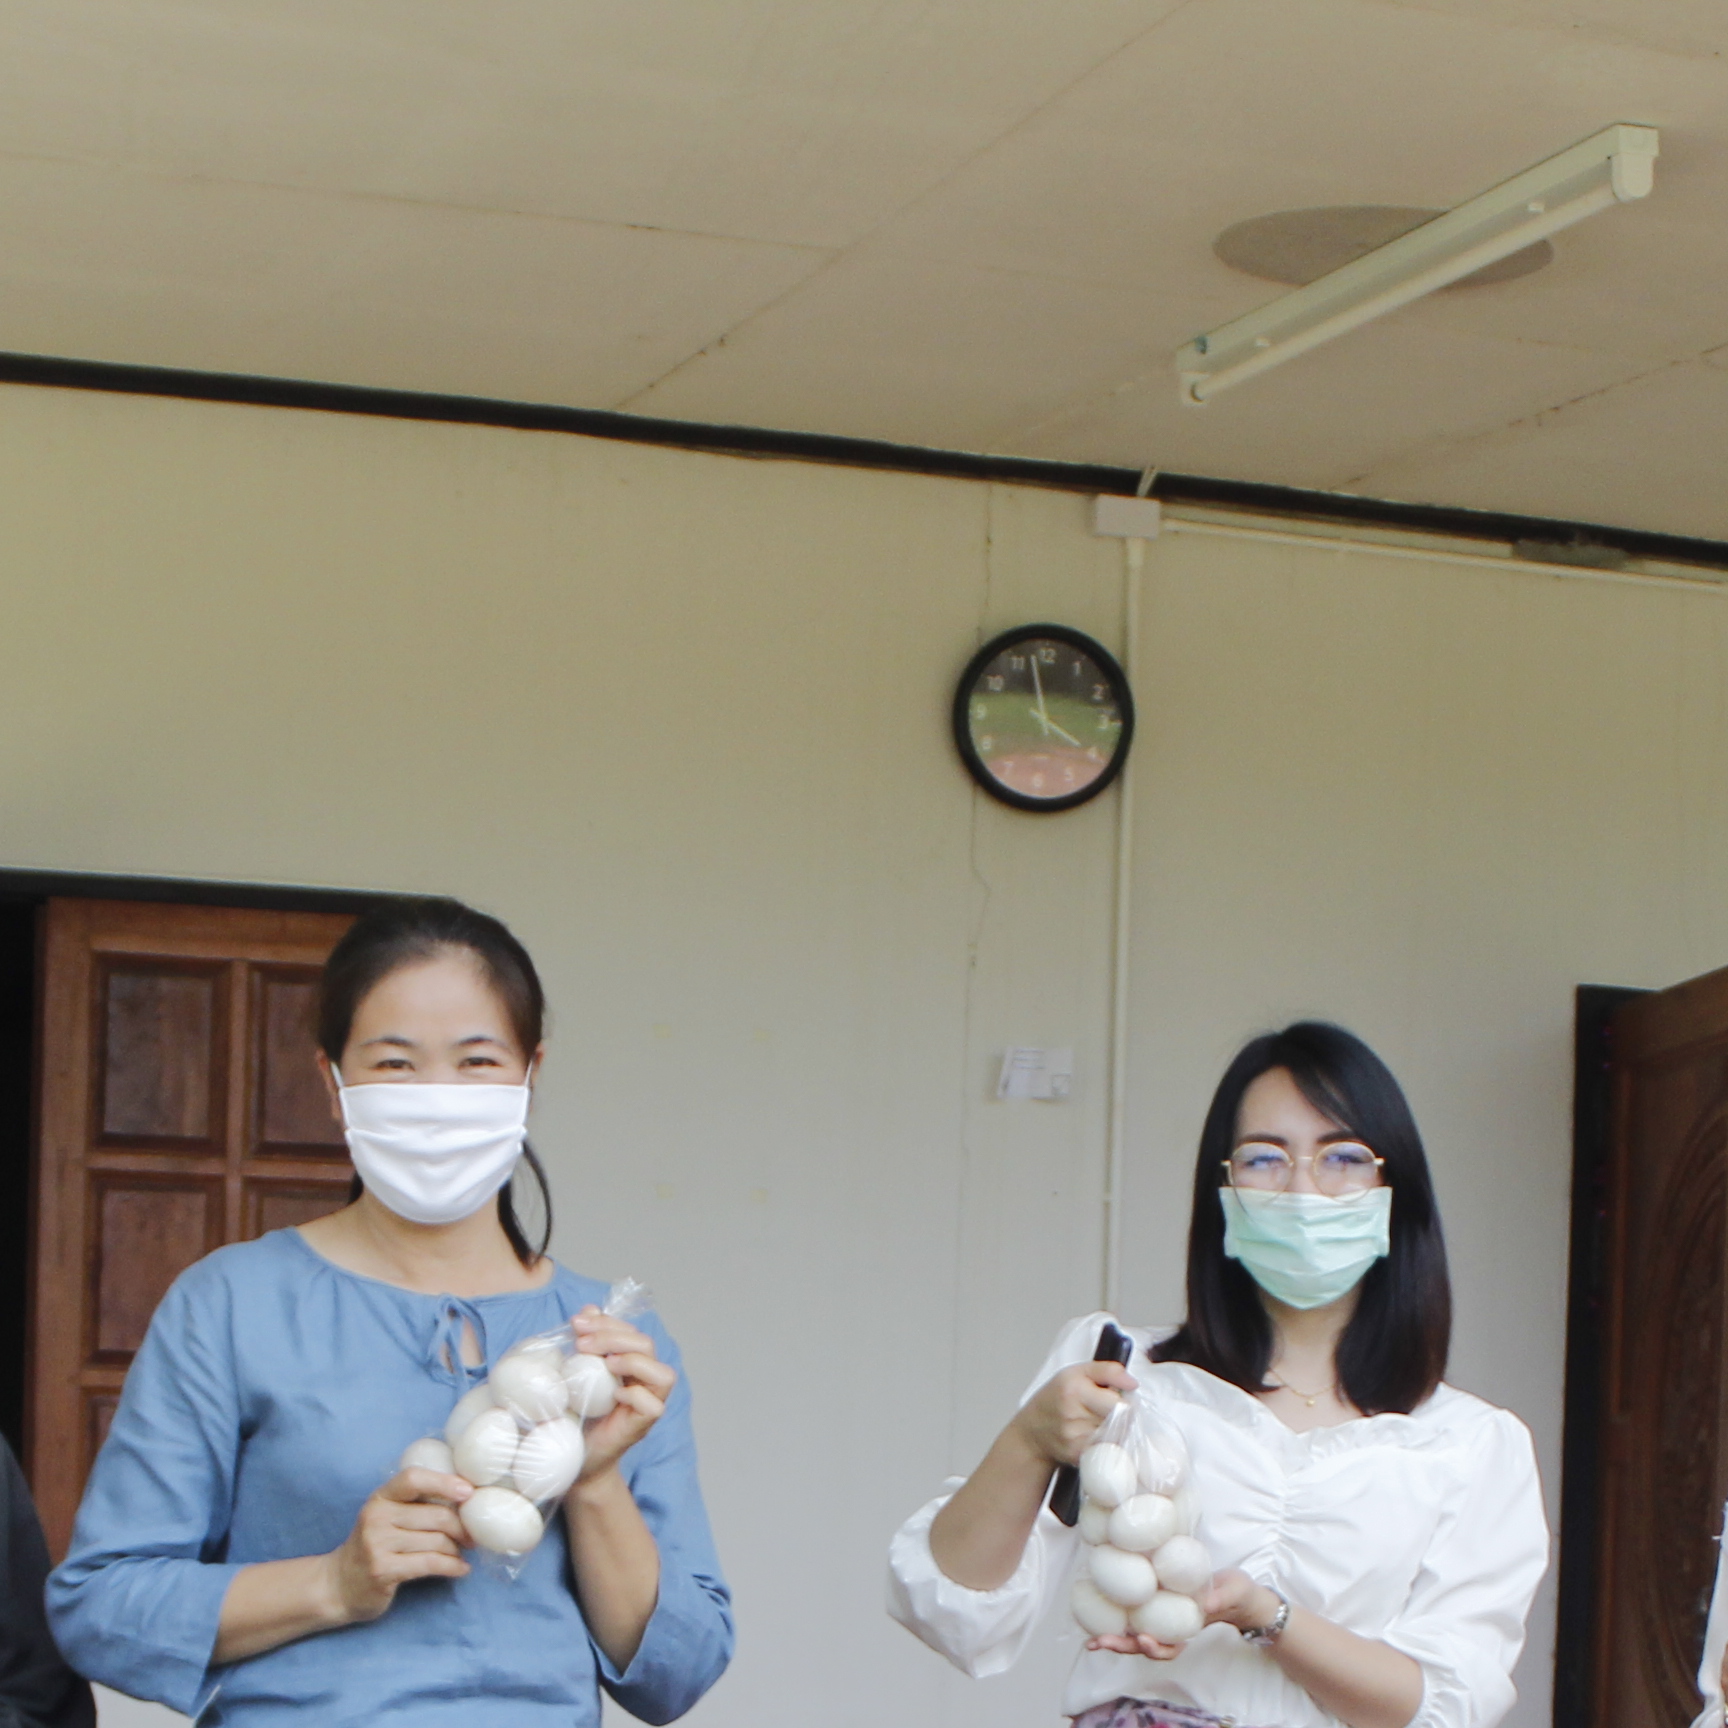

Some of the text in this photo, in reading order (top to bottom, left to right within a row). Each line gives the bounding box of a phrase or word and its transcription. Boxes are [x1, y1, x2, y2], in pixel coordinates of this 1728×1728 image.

[1012, 656, 1024, 670] 11
[1040, 649, 1056, 664] 12
[1074, 661, 1081, 675] 1
[987, 676, 1004, 692] 10
[1092, 685, 1104, 700] 2
[976, 704, 986, 720] 9
[1098, 714, 1109, 729] 3
[981, 736, 991, 750] 8
[1087, 746, 1098, 760] 4
[1004, 761, 1013, 774] 7
[1032, 773, 1045, 788] 6
